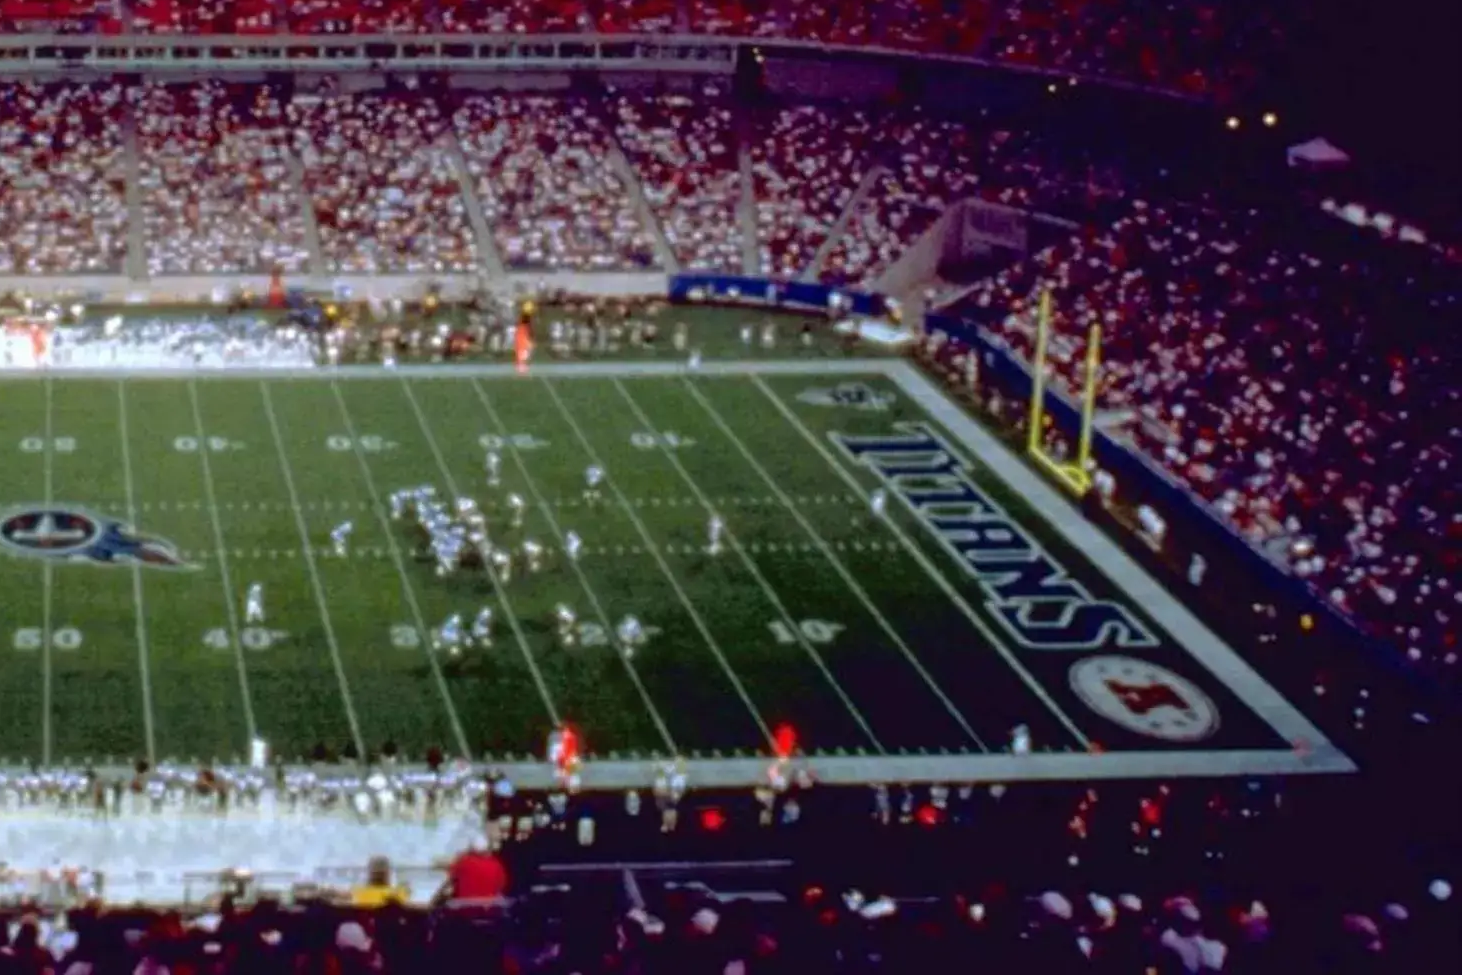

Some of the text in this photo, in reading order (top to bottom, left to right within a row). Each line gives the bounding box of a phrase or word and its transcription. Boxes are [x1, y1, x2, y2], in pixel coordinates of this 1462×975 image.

[13, 627, 83, 650] 50
[202, 627, 272, 650] 40
[768, 620, 836, 644] 10
